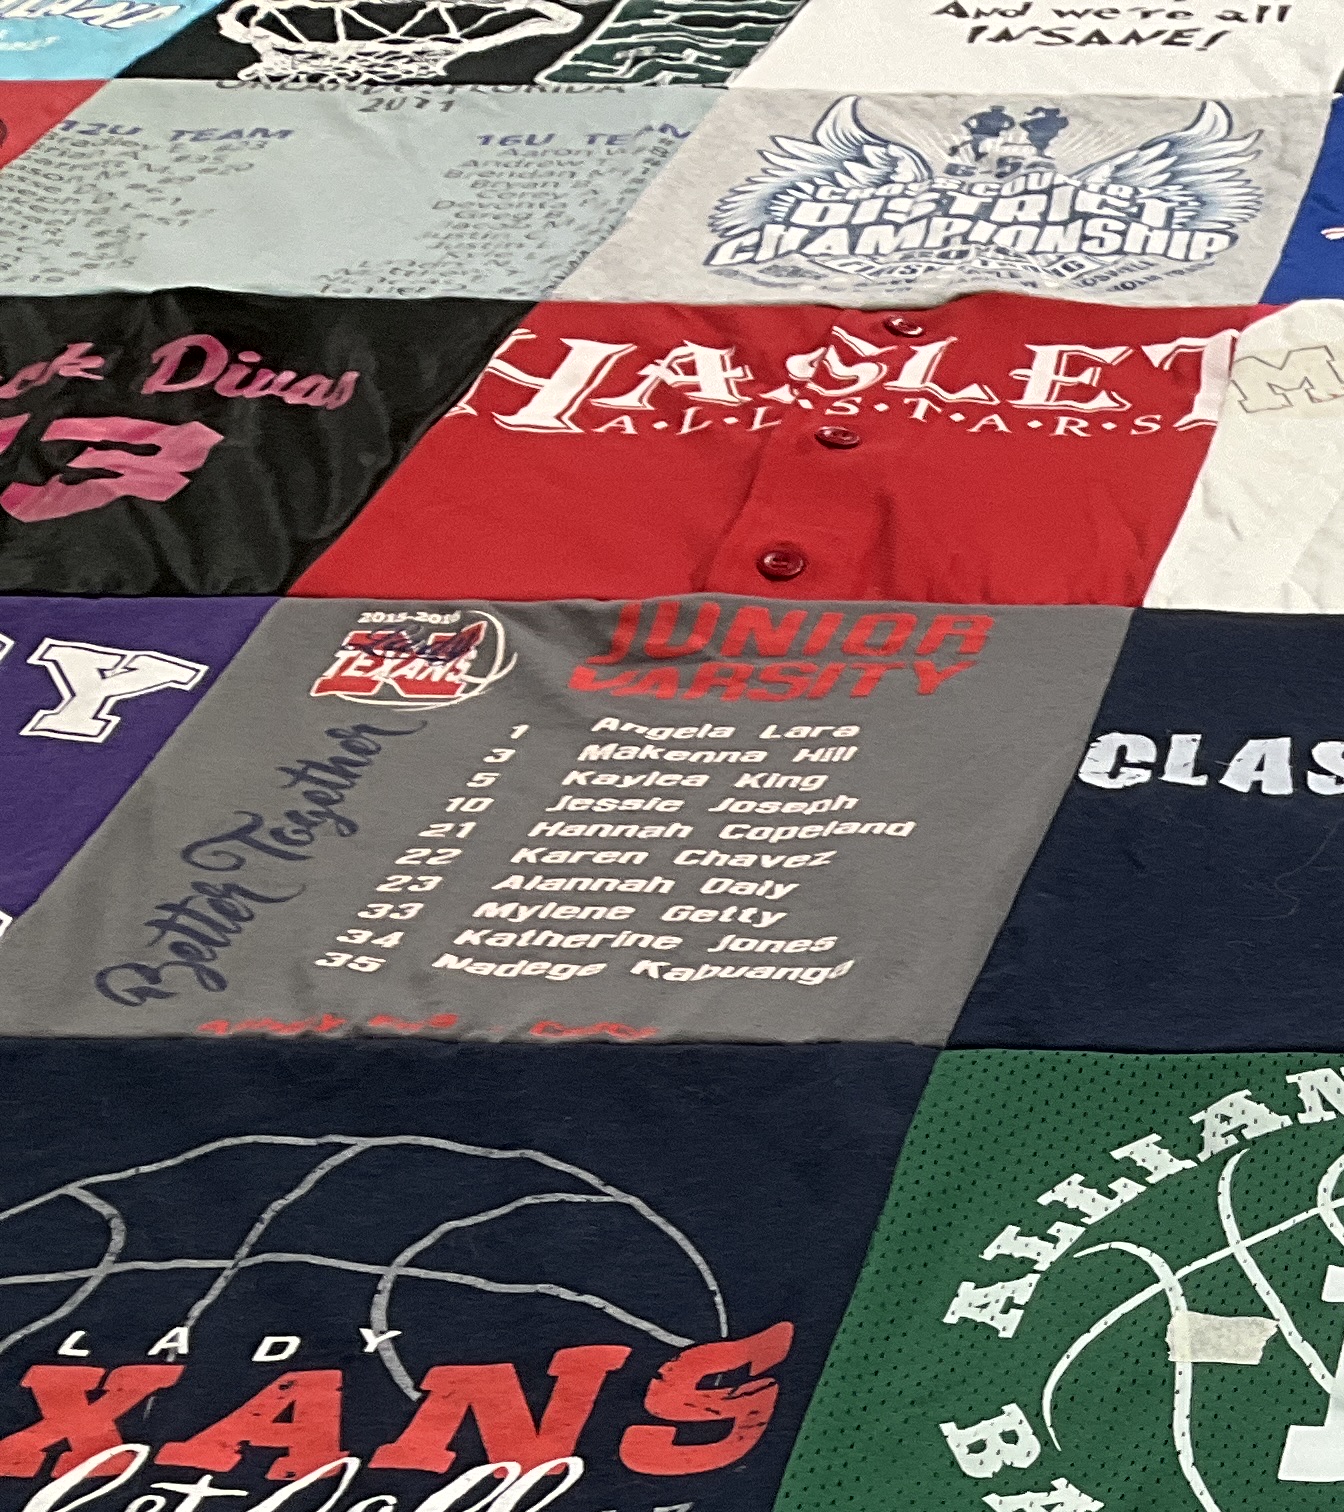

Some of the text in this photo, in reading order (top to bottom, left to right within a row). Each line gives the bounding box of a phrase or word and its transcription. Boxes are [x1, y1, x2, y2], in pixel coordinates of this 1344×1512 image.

[931, 0, 1292, 24] And we're all
[966, 25, 1231, 51] INSANE!
[169, 127, 295, 143] TEAM
[788, 184, 1174, 230] DISTRICT
[702, 215, 1240, 267] CHAMPIONSHIP
[141, 333, 360, 409] Divas
[446, 324, 1242, 435] HASLET
[585, 602, 996, 664] JUNIOR
[567, 660, 976, 703] VARSITY
[510, 717, 860, 741] 1 Angela Lara
[483, 743, 858, 764] 3 Makenna Hill
[466, 770, 829, 792] 5 Kaylea King
[181, 718, 429, 872] Together
[445, 794, 860, 816] 10 Jessie Joseph
[418, 820, 916, 843] 21 Hannah Copeland
[394, 847, 838, 868] 22 Karen Chavez
[375, 874, 800, 900] 23 Alannah Daly
[357, 901, 788, 928] 33 Mylene Getty
[94, 880, 307, 1008] Better
[336, 929, 838, 953] 34 Katherine Jones
[314, 951, 855, 986] 35 Nadege Kabuanga
[55, 1326, 403, 1364] LADY
[0, 1320, 796, 1480] XANS
